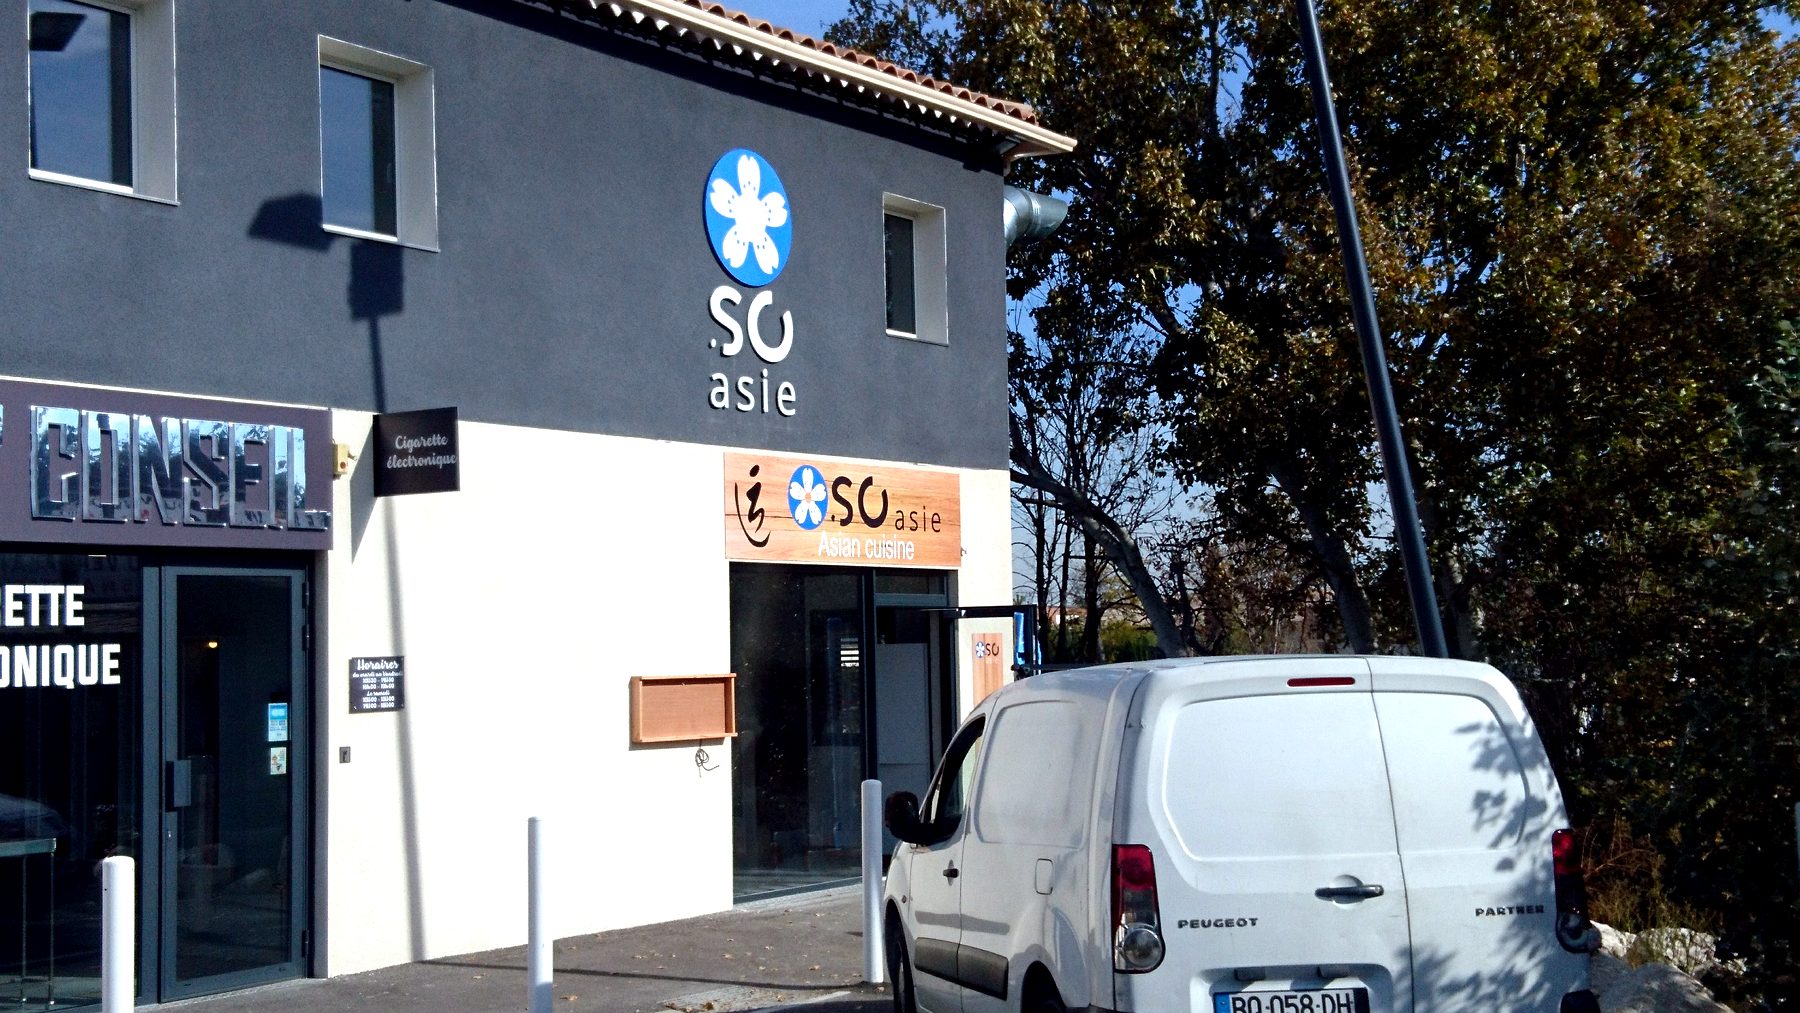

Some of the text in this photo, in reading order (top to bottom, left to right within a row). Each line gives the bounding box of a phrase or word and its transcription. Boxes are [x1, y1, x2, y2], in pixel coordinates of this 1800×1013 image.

[709, 368, 797, 416] asie
[395, 433, 449, 453] Cigarette
[30, 404, 331, 531] CONSEIL
[386, 452, 457, 469] électronique
[894, 505, 942, 533] asie
[818, 531, 915, 560] Asian cuisine
[0, 584, 85, 627] ETTE
[357, 659, 399, 670] Horaires
[1475, 904, 1545, 917] PARTNER
[1177, 917, 1258, 929] PEUGEOT
